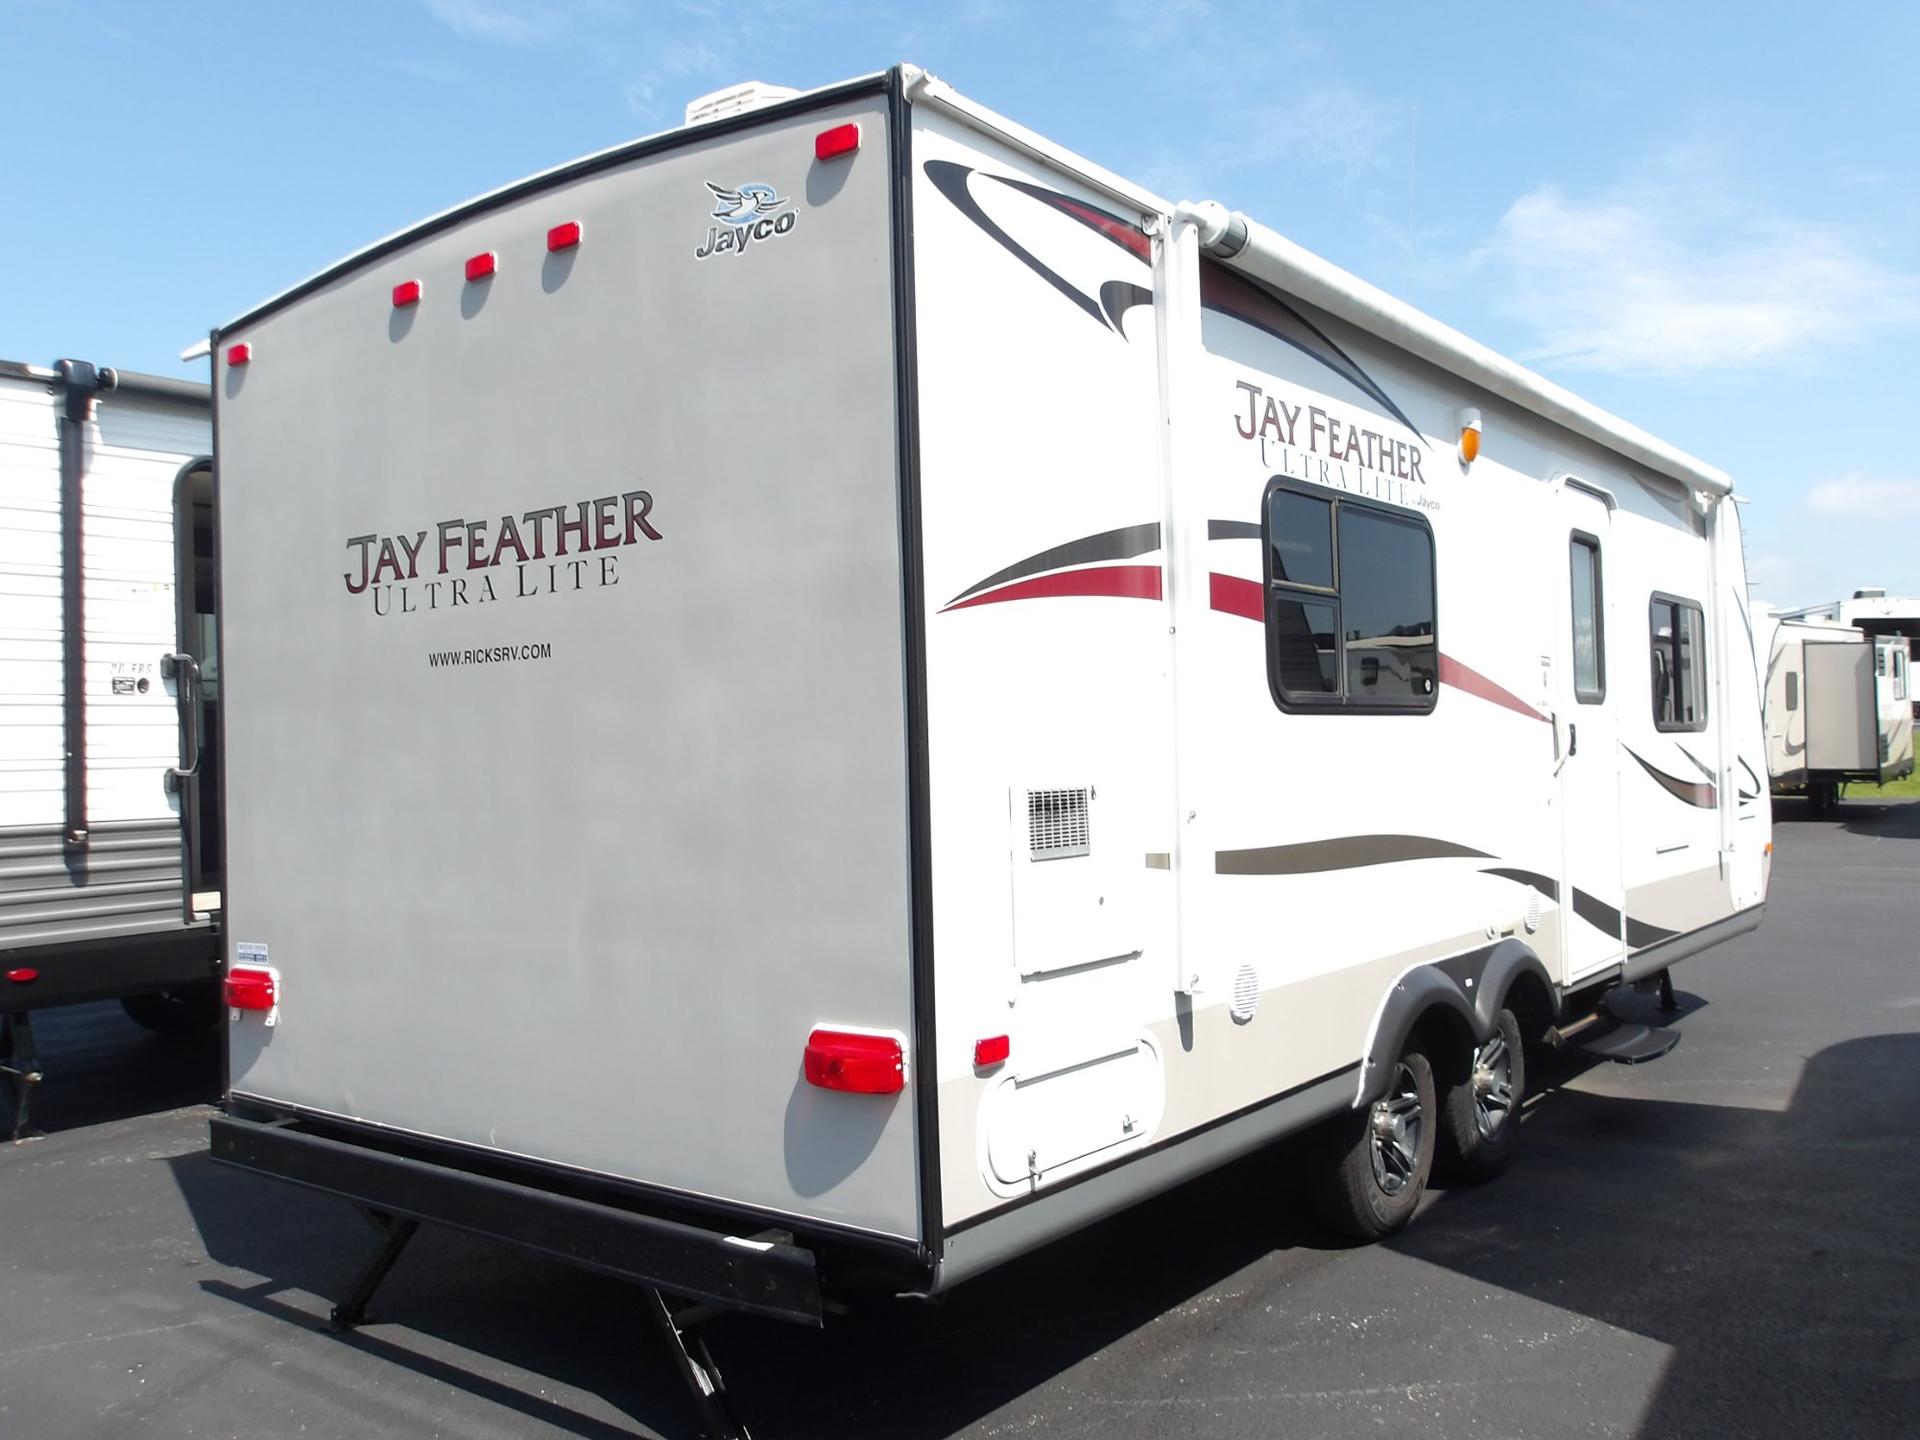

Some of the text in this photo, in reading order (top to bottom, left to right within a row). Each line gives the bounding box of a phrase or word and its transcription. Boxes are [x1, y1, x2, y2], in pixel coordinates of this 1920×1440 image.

[695, 211, 798, 258] Jayco
[1234, 380, 1426, 484] JAY FEATHER
[1260, 437, 1408, 505] ULTRA LITE
[1416, 494, 1440, 511] Jayco
[344, 490, 663, 594] JAY FEATHER
[372, 555, 619, 616] ULTRA LITE
[429, 643, 551, 667] WWW.RICKSRV.COM
